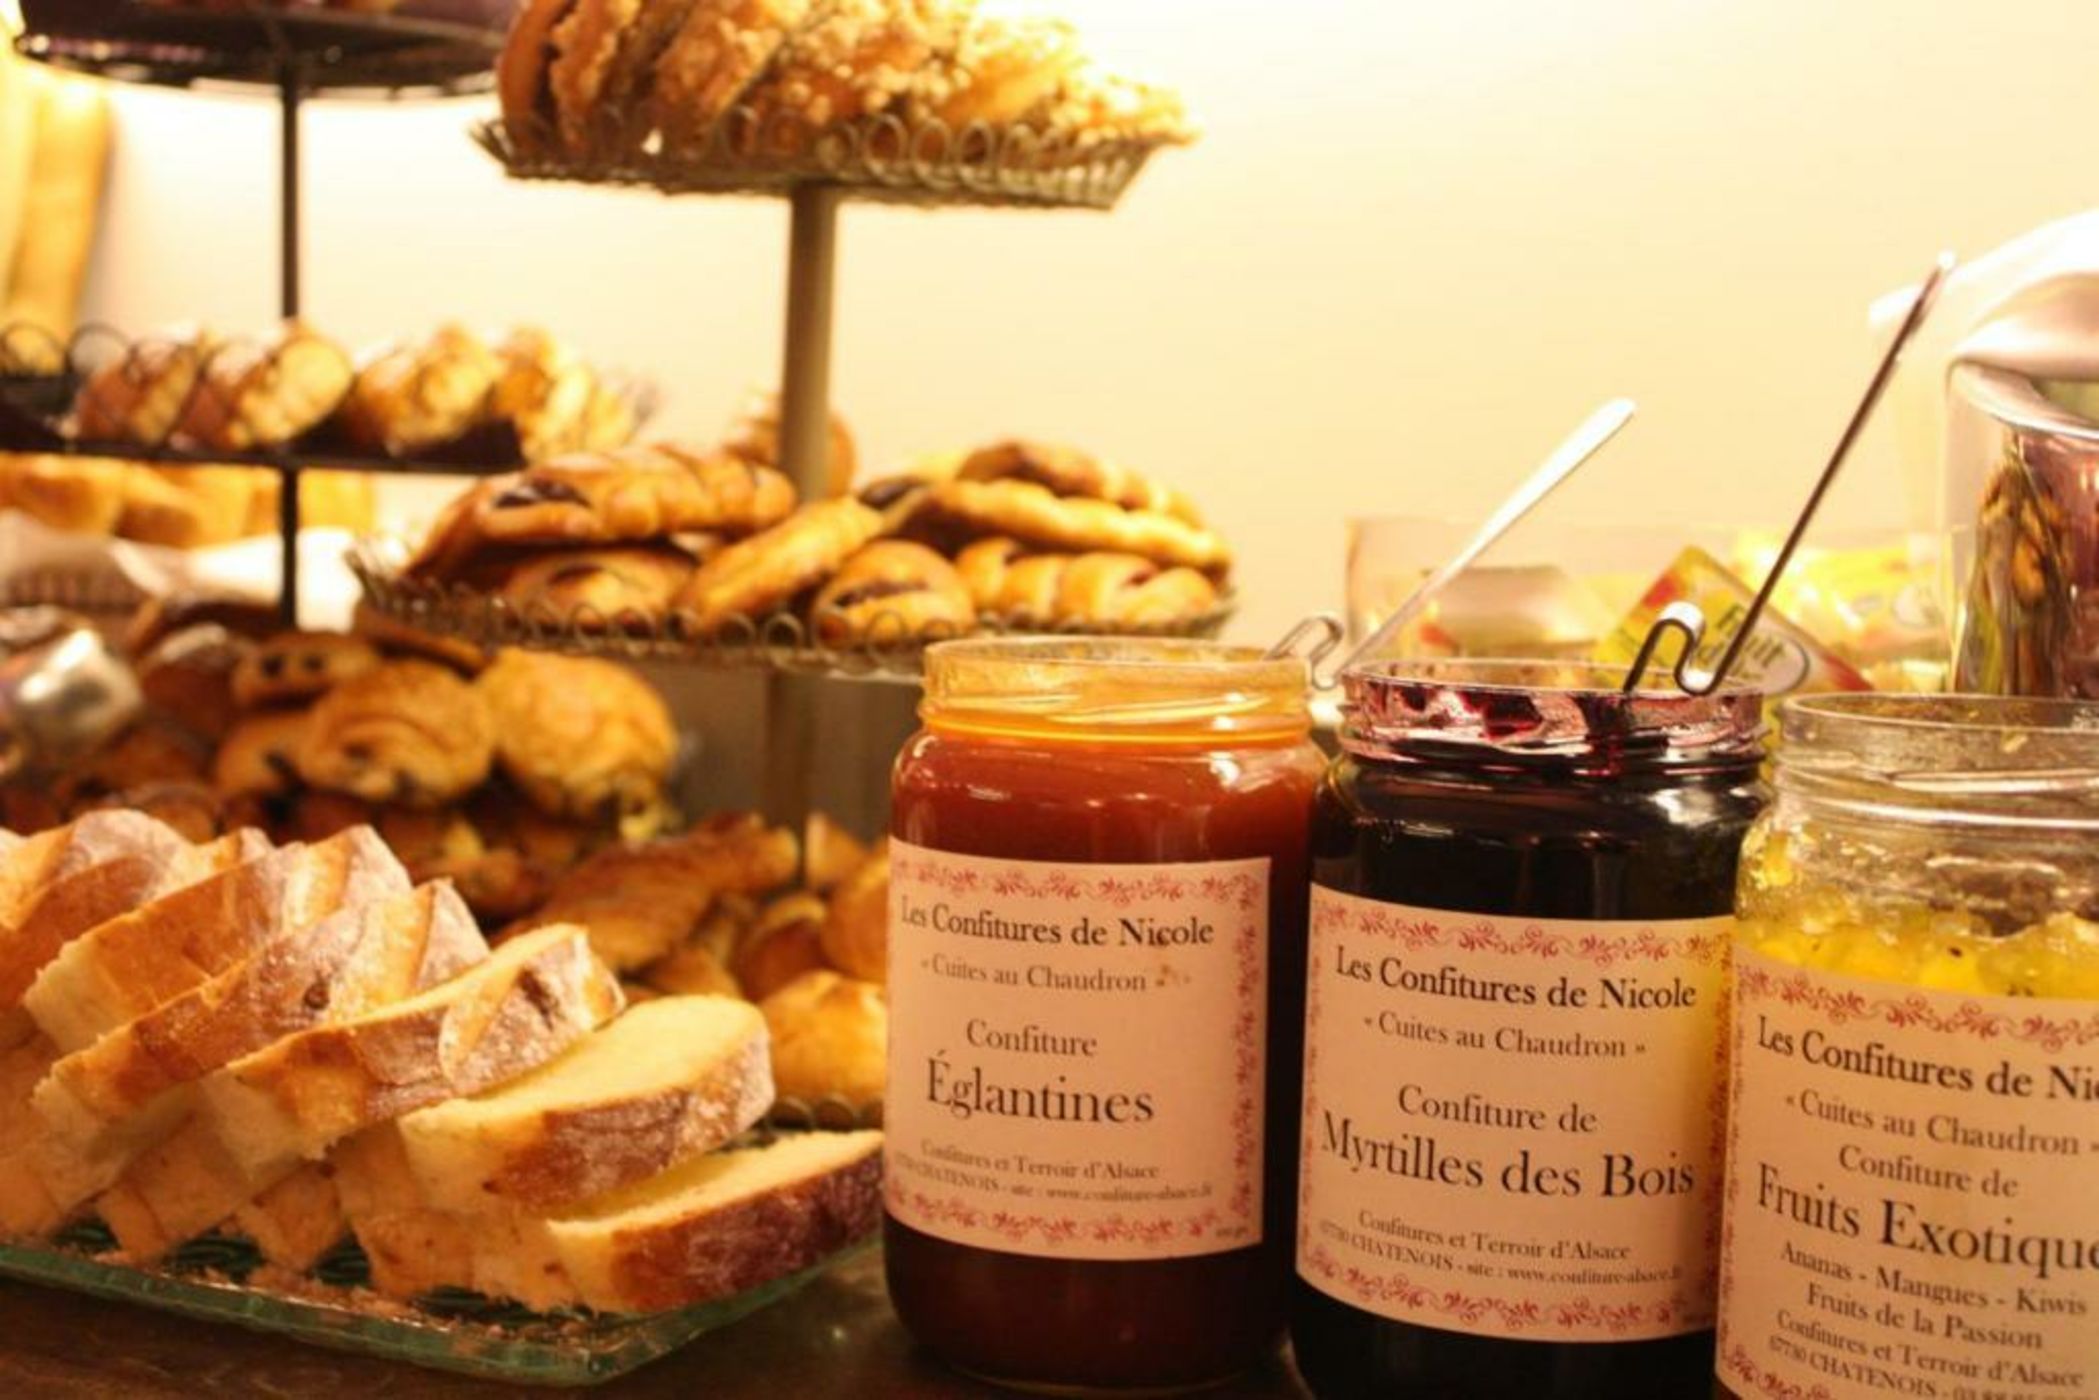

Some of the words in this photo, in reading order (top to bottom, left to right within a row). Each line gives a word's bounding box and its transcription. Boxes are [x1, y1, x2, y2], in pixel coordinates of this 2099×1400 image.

[901, 895, 927, 927] Les
[932, 903, 1062, 943] Confitures
[1071, 917, 1107, 946] de
[1118, 916, 1213, 946] Nicole
[932, 952, 988, 982] Cuites
[994, 967, 1018, 985] au
[1027, 965, 1147, 992] Chaudron
[1337, 945, 1372, 982] Les
[1380, 957, 1537, 1005] Confitures
[1547, 976, 1587, 1008] de
[1600, 977, 1696, 1009] Nicole
[967, 1018, 1097, 1056] Confiture
[1379, 1010, 1448, 1044] Cuites
[1456, 1030, 1485, 1049] au
[1495, 1027, 1625, 1057] Chaudron
[1758, 1015, 1794, 1056] Les
[1801, 1029, 1974, 1092] Confitures
[1986, 1060, 2032, 1097] de
[2046, 1065, 2099, 1101] Ni
[928, 1049, 1154, 1123] Églantines
[1399, 1084, 1546, 1130] Confiture
[1559, 1102, 1598, 1132] de
[1800, 1088, 1874, 1130] Cuites
[1883, 1114, 1915, 1138] au
[1927, 1114, 2079, 1156] Chaudron
[1014, 1155, 1077, 1177] Terroir
[1322, 1109, 1483, 1188] Myrtilles
[1501, 1150, 1581, 1196] des
[1602, 1151, 1695, 1197] Bois
[1839, 1144, 1972, 1193] Confiture
[1981, 1167, 2018, 1198] de
[1759, 1161, 1861, 1239] Fruits
[1358, 1209, 1444, 1246] Confitures
[1449, 1232, 1466, 1248] et
[1471, 1231, 1544, 1257] Terroir
[1550, 1239, 1631, 1260] d'Alsace
[1781, 1240, 1851, 1281] Ananas
[1875, 1265, 1989, 1307] Mangues
[2016, 1287, 2087, 1316] Kiwis
[1808, 1281, 1868, 1320] Fruits
[1875, 1302, 1905, 1329] de
[1913, 1308, 1934, 1335] la
[1945, 1314, 2042, 1349] Passion
[1777, 1309, 1867, 1356] Confitures
[1873, 1345, 1891, 1362] et
[1897, 1343, 1978, 1378] Terroir
[1988, 1360, 2083, 1387] d'Alsace
[1809, 1351, 1936, 1397] CHATENOIS
